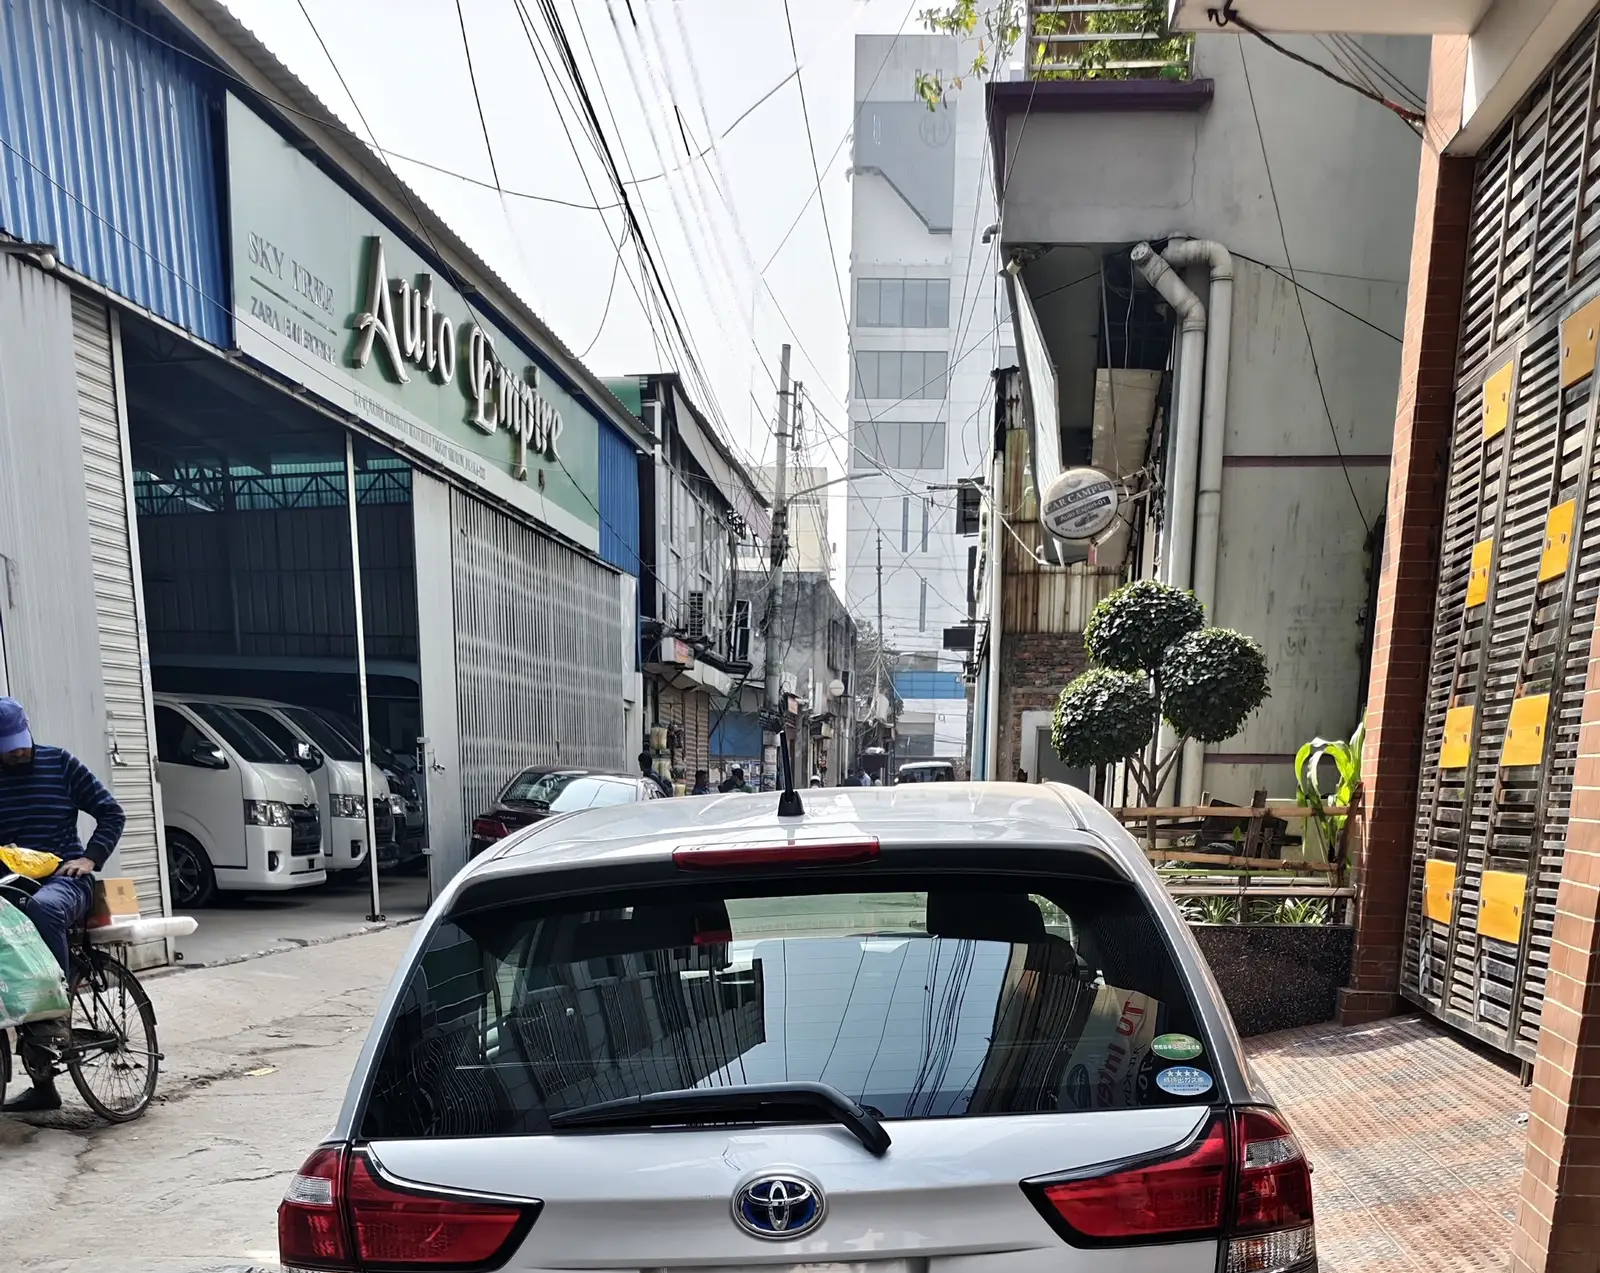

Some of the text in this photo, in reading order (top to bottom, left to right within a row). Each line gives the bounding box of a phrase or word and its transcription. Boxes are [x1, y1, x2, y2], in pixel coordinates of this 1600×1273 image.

[248, 231, 284, 281] SKY
[250, 295, 281, 332] ZARA
[352, 235, 456, 386] Auto
[467, 323, 564, 482] Empire
[1045, 500, 1067, 513] CAR
[1067, 482, 1111, 502] CAMPUS
[1060, 511, 1076, 522] Auto
